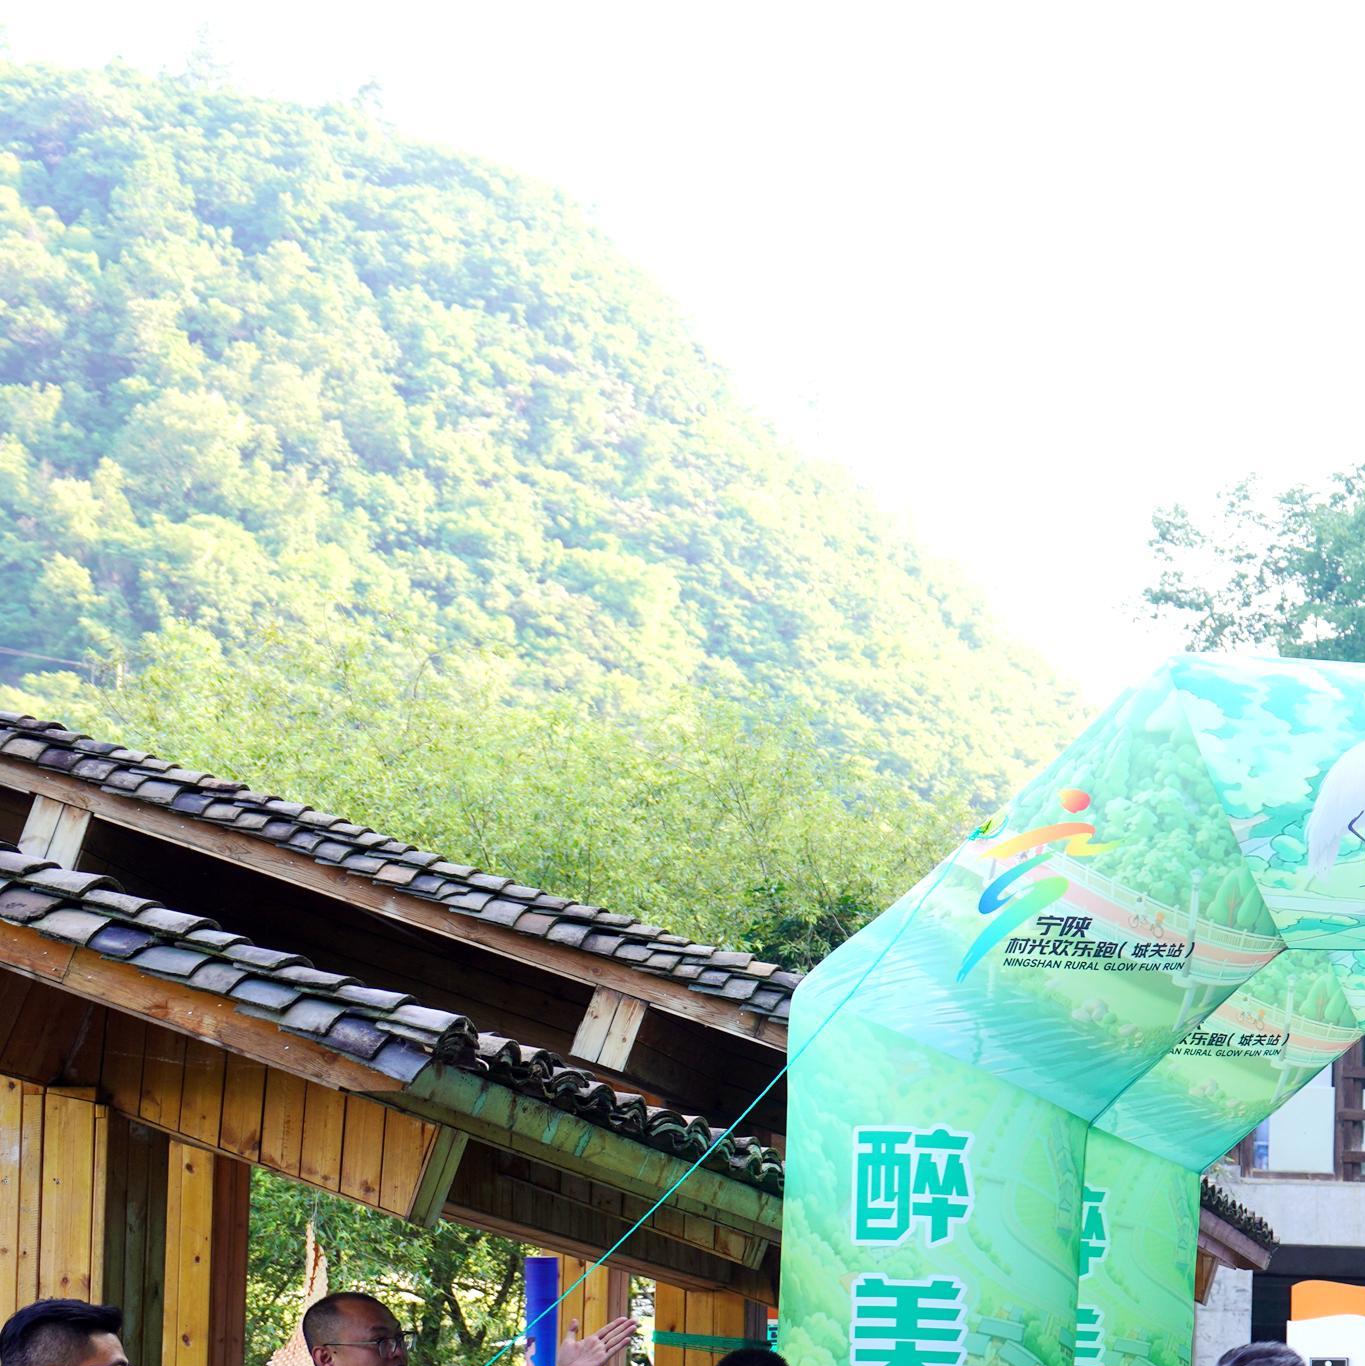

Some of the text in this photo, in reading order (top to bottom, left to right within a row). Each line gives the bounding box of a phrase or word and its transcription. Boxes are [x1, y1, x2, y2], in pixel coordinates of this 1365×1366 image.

[1036, 915, 1093, 938] 宁陕
[1003, 958, 1185, 972] NINGSHAN RURAL GLOW FUN RUN
[1183, 1048, 1212, 1057] RURAL
[1215, 1049, 1242, 1057] GLOW
[1243, 1049, 1262, 1057] FUN
[1263, 1048, 1281, 1056] RUN
